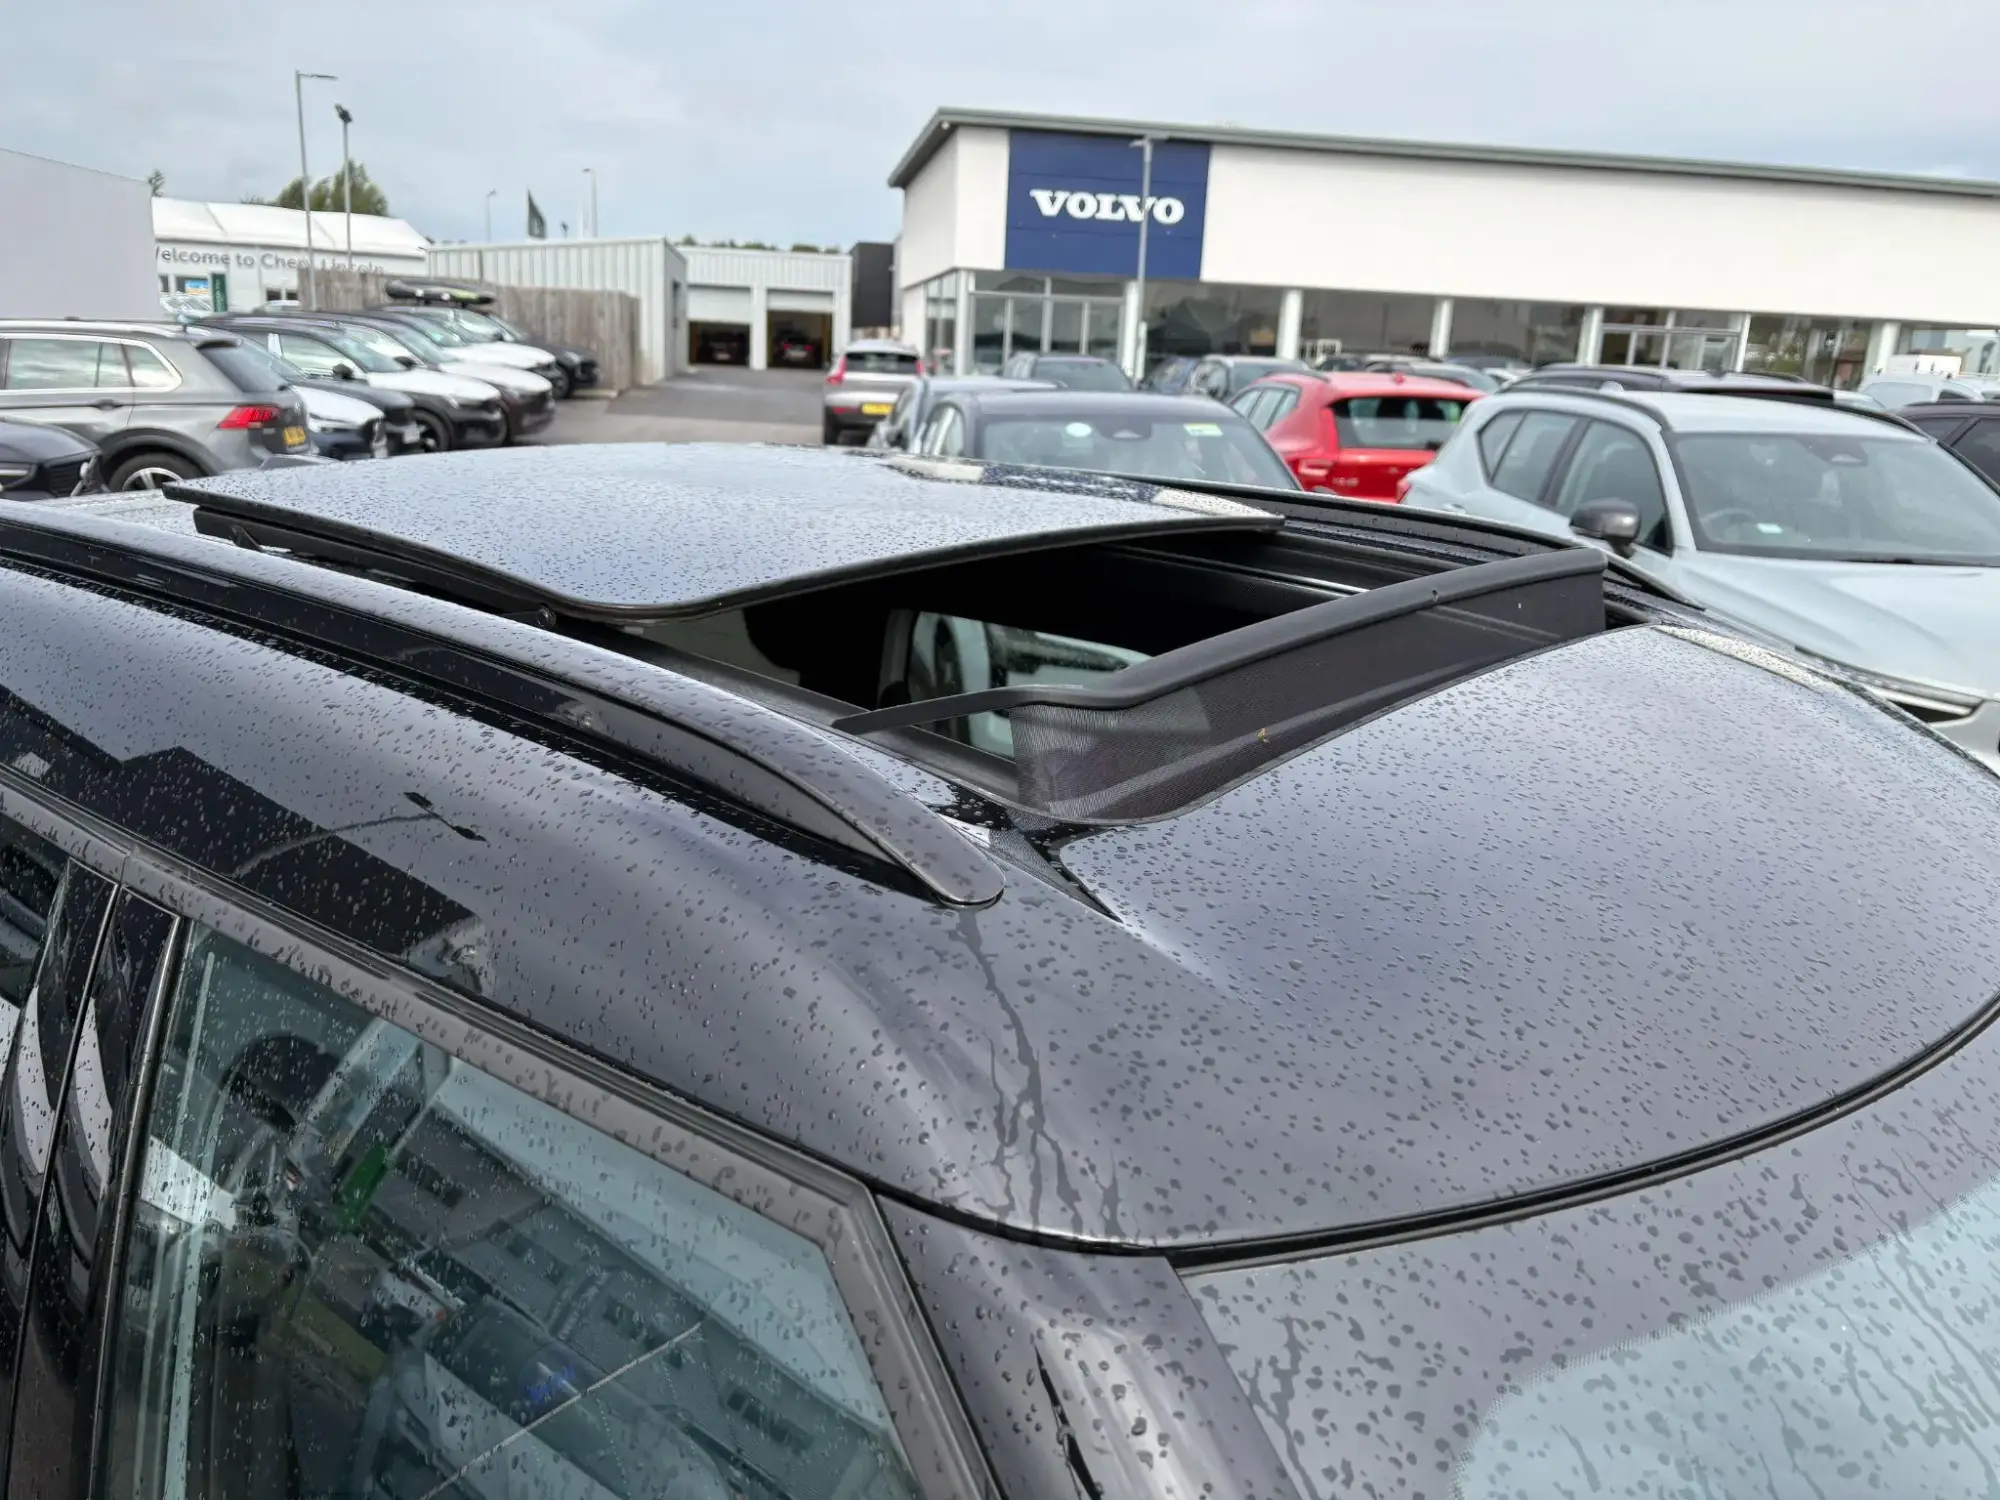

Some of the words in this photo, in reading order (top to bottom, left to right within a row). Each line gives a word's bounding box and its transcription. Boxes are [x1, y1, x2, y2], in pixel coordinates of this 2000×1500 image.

[1029, 189, 1185, 225] VOLVO
[156, 246, 230, 264] elcome
[236, 252, 255, 267] to
